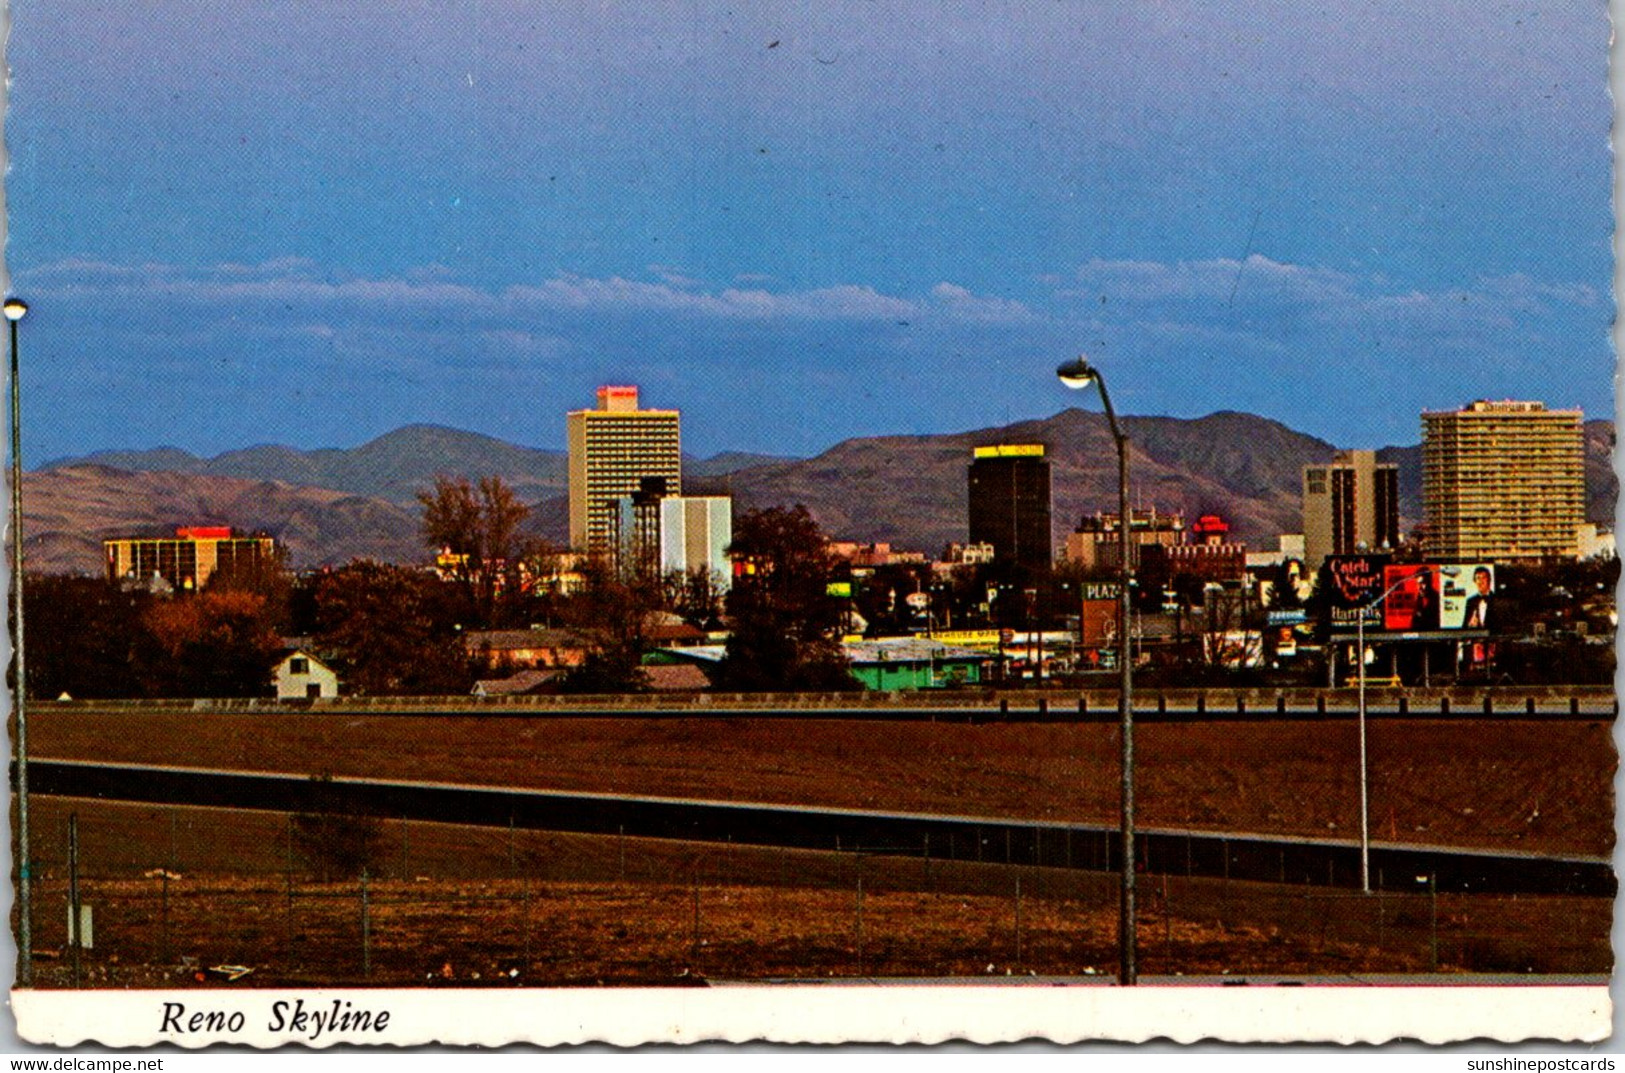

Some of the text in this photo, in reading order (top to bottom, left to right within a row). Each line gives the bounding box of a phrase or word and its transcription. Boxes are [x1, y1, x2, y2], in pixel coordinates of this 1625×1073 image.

[1330, 559, 1369, 574] Catch
[1345, 572, 1381, 588] Star!
[160, 1000, 390, 1040] Reno Skyline
